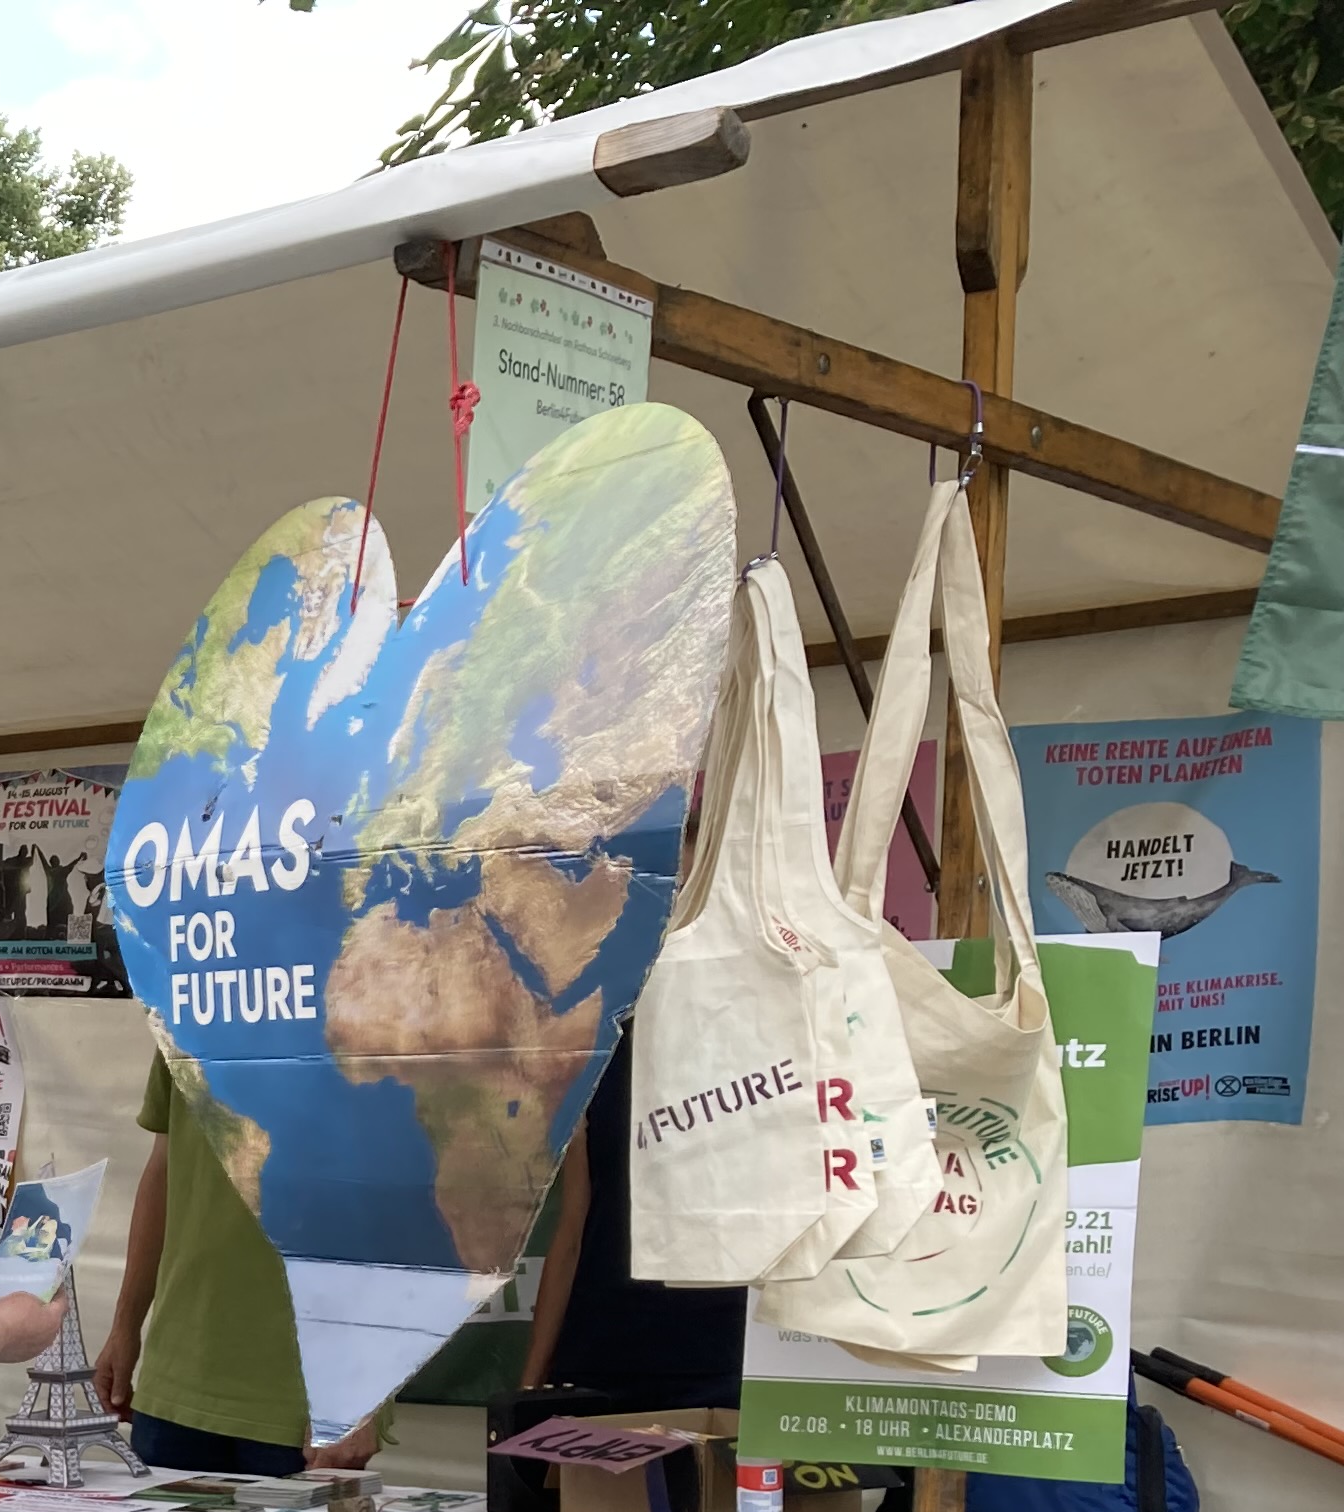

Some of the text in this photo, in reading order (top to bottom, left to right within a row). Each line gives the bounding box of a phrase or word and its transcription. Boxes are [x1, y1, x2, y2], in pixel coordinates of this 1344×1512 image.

[498, 348, 626, 407] Stand-Nummer: 58
[1045, 727, 1273, 764] KEINE RENTE AUF EINEM
[1075, 754, 1243, 786] TOTEN PLANETEN
[33, 786, 70, 798] AUGUST
[9, 820, 27, 831] FOR
[29, 820, 49, 830] OUR
[53, 819, 90, 829] FUTURE
[123, 798, 316, 908] OMAS
[1106, 834, 1195, 860] HANDELT
[1120, 858, 1184, 881] JETZT!
[169, 910, 238, 962] FOR
[171, 963, 317, 1026] FUTURE
[1157, 972, 1284, 997] DIE KLIMAKRISE.
[1157, 992, 1226, 1013] MIT UNS!
[1181, 1025, 1261, 1050] BERLIN
[1058, 1038, 1107, 1068] tz
[1147, 1073, 1210, 1104] RISE UP!
[1068, 1308, 1109, 1335] FUTURE
[844, 1395, 1018, 1424] KLIMAMONTAGS-DEMO
[779, 1415, 1074, 1451] 02.08. 18 UHR ALEXANDERPLATZ
